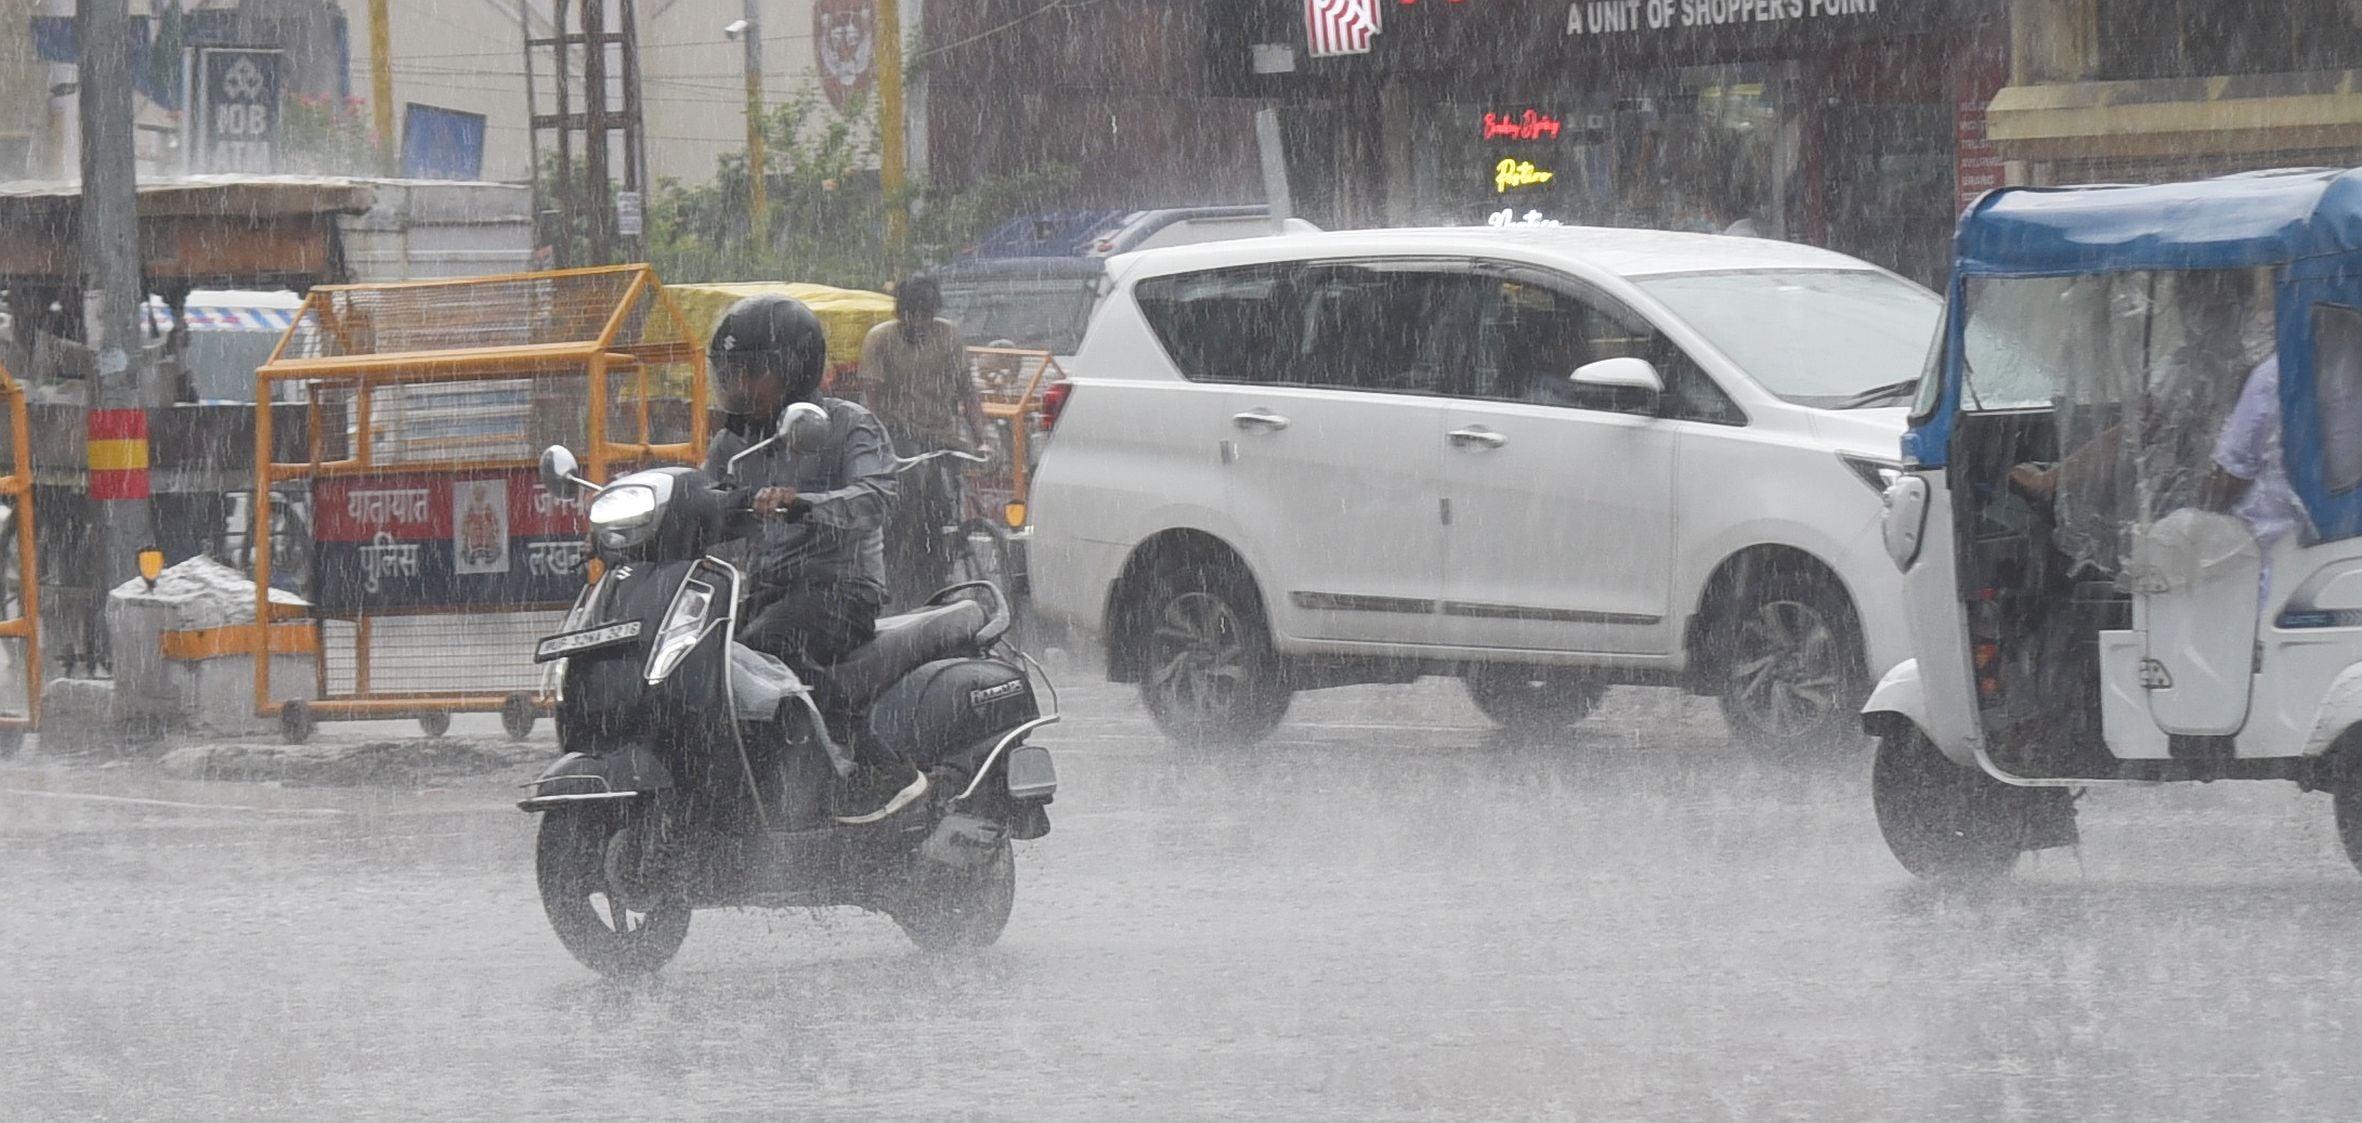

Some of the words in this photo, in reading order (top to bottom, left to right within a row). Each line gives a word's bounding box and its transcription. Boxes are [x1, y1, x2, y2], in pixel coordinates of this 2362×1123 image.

[1566, 3, 1583, 35] A
[1587, 0, 1641, 34] UNIT
[1647, 0, 1676, 29] OF
[347, 489, 430, 524] यातायात
[358, 531, 420, 593] पुलिस
